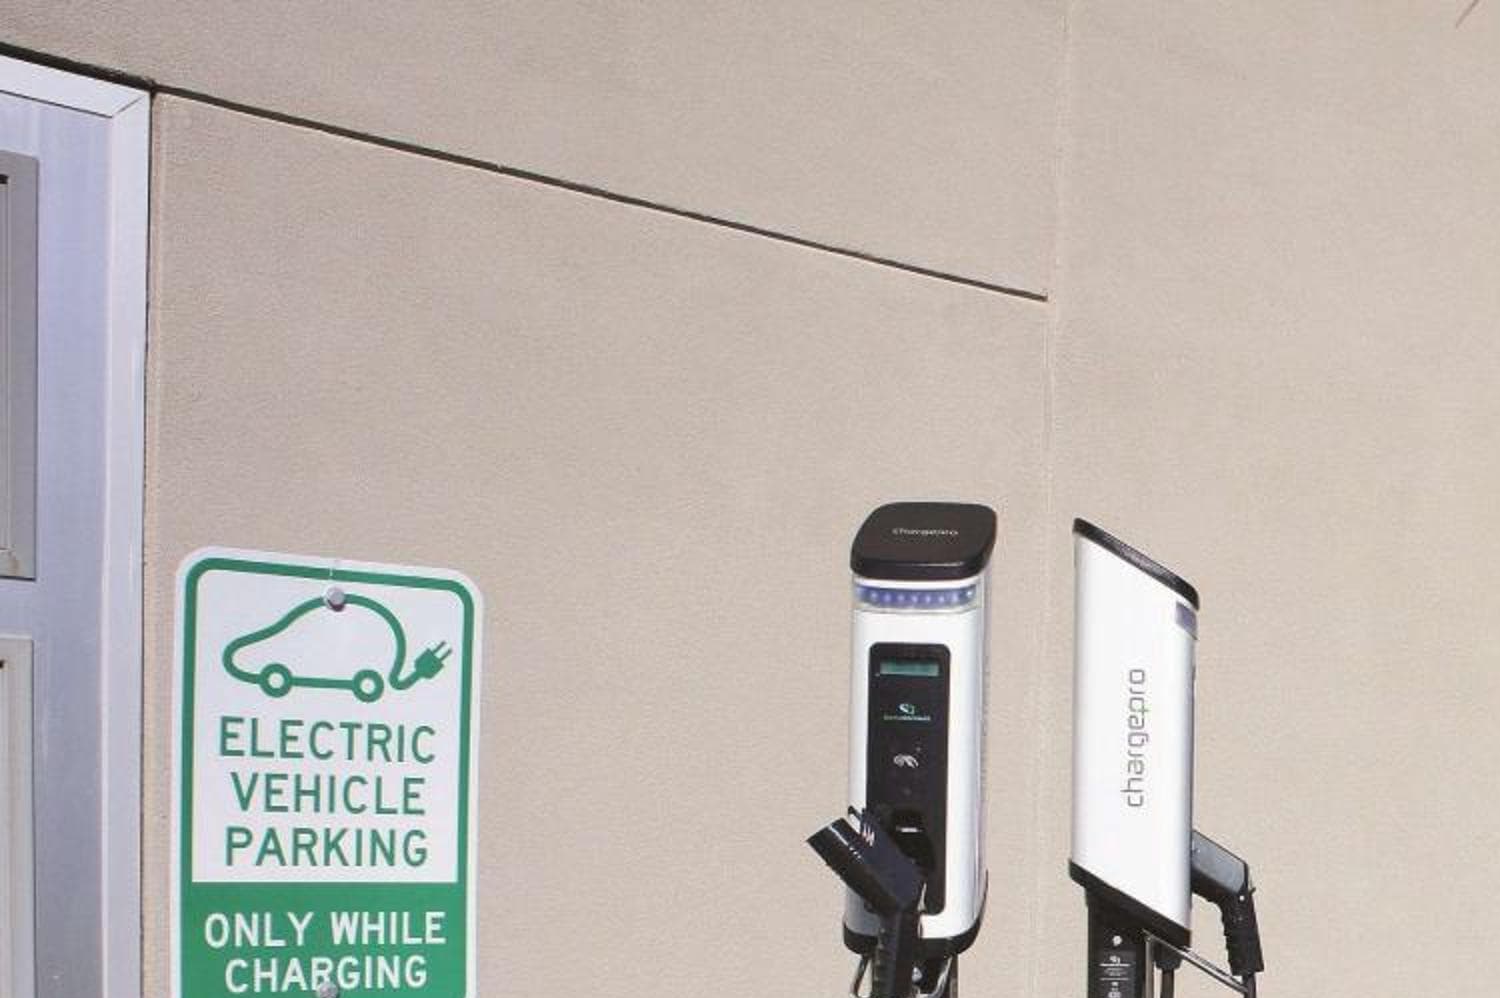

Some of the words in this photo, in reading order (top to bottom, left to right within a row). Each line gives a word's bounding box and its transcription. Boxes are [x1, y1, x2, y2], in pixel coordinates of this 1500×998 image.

[219, 716, 436, 764] ELECTRIC
[1120, 669, 1149, 807] chargepro
[230, 772, 426, 815] VEHICLE
[225, 826, 428, 867] PARKING
[205, 912, 314, 948] ONLY
[330, 911, 446, 945] WHILE
[225, 956, 427, 993] CHARGING
